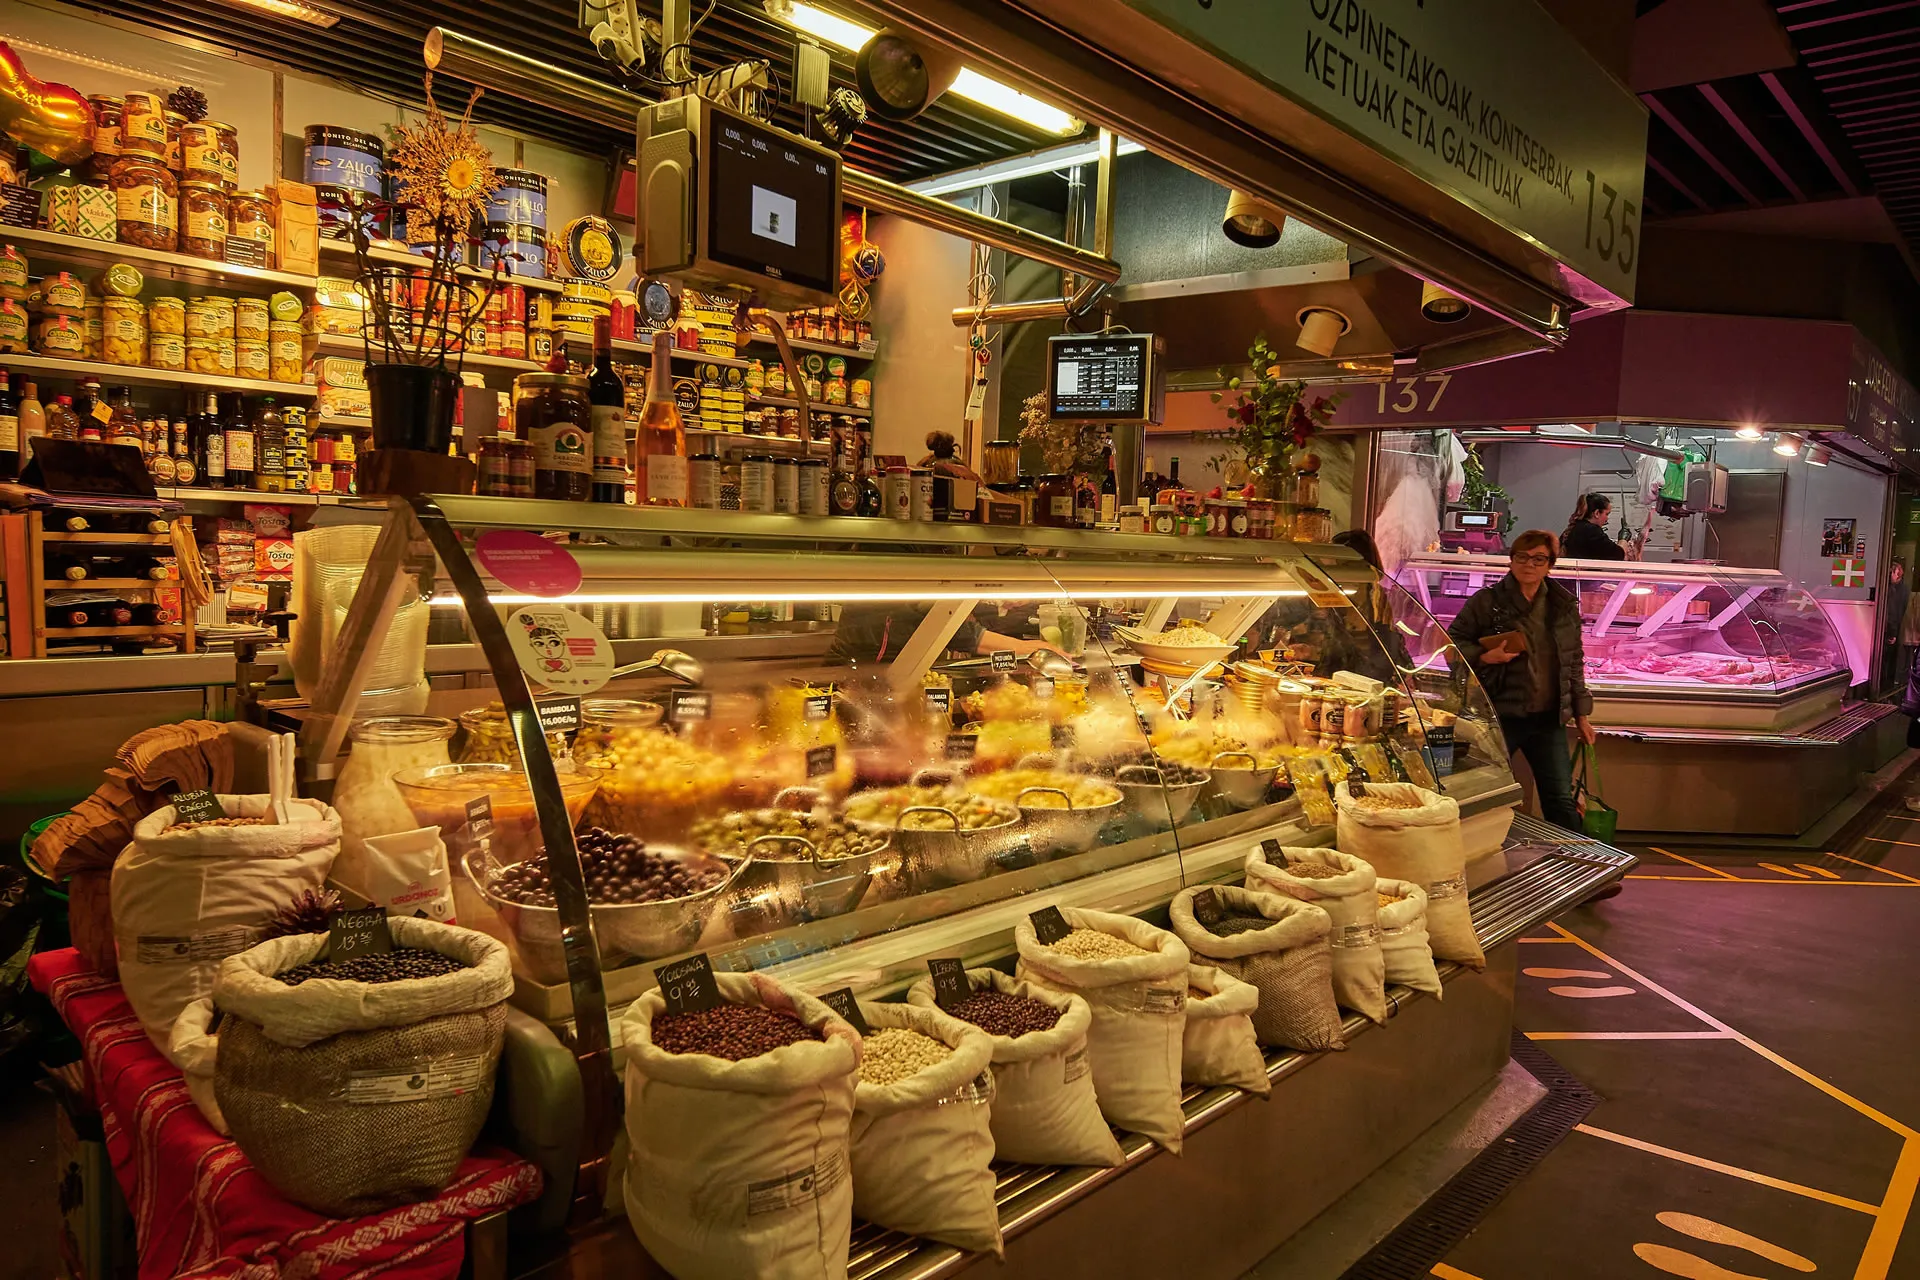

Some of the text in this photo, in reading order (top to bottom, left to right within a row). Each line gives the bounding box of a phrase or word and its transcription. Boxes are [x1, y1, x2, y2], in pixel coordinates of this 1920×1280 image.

[1305, 30, 1523, 208] KETUAK ETA GAZITUAK
[322, 132, 351, 141] BONITO
[1479, 100, 1574, 205] KONTSERBAK,
[337, 158, 374, 176] ZALLO
[86, 207, 112, 219] Maldon
[1585, 169, 1636, 274] 135
[583, 265, 607, 278] ZALLO
[587, 287, 607, 297] ZALLO
[646, 316, 667, 329] ZALLO
[712, 313, 731, 321] ZALLO
[471, 330, 485, 341] LC
[537, 341, 550, 352] LC
[1378, 374, 1452, 413] 137
[677, 400, 694, 409] ZALLO
[1847, 379, 1861, 422] 137
[257, 517, 286, 526] Tostas
